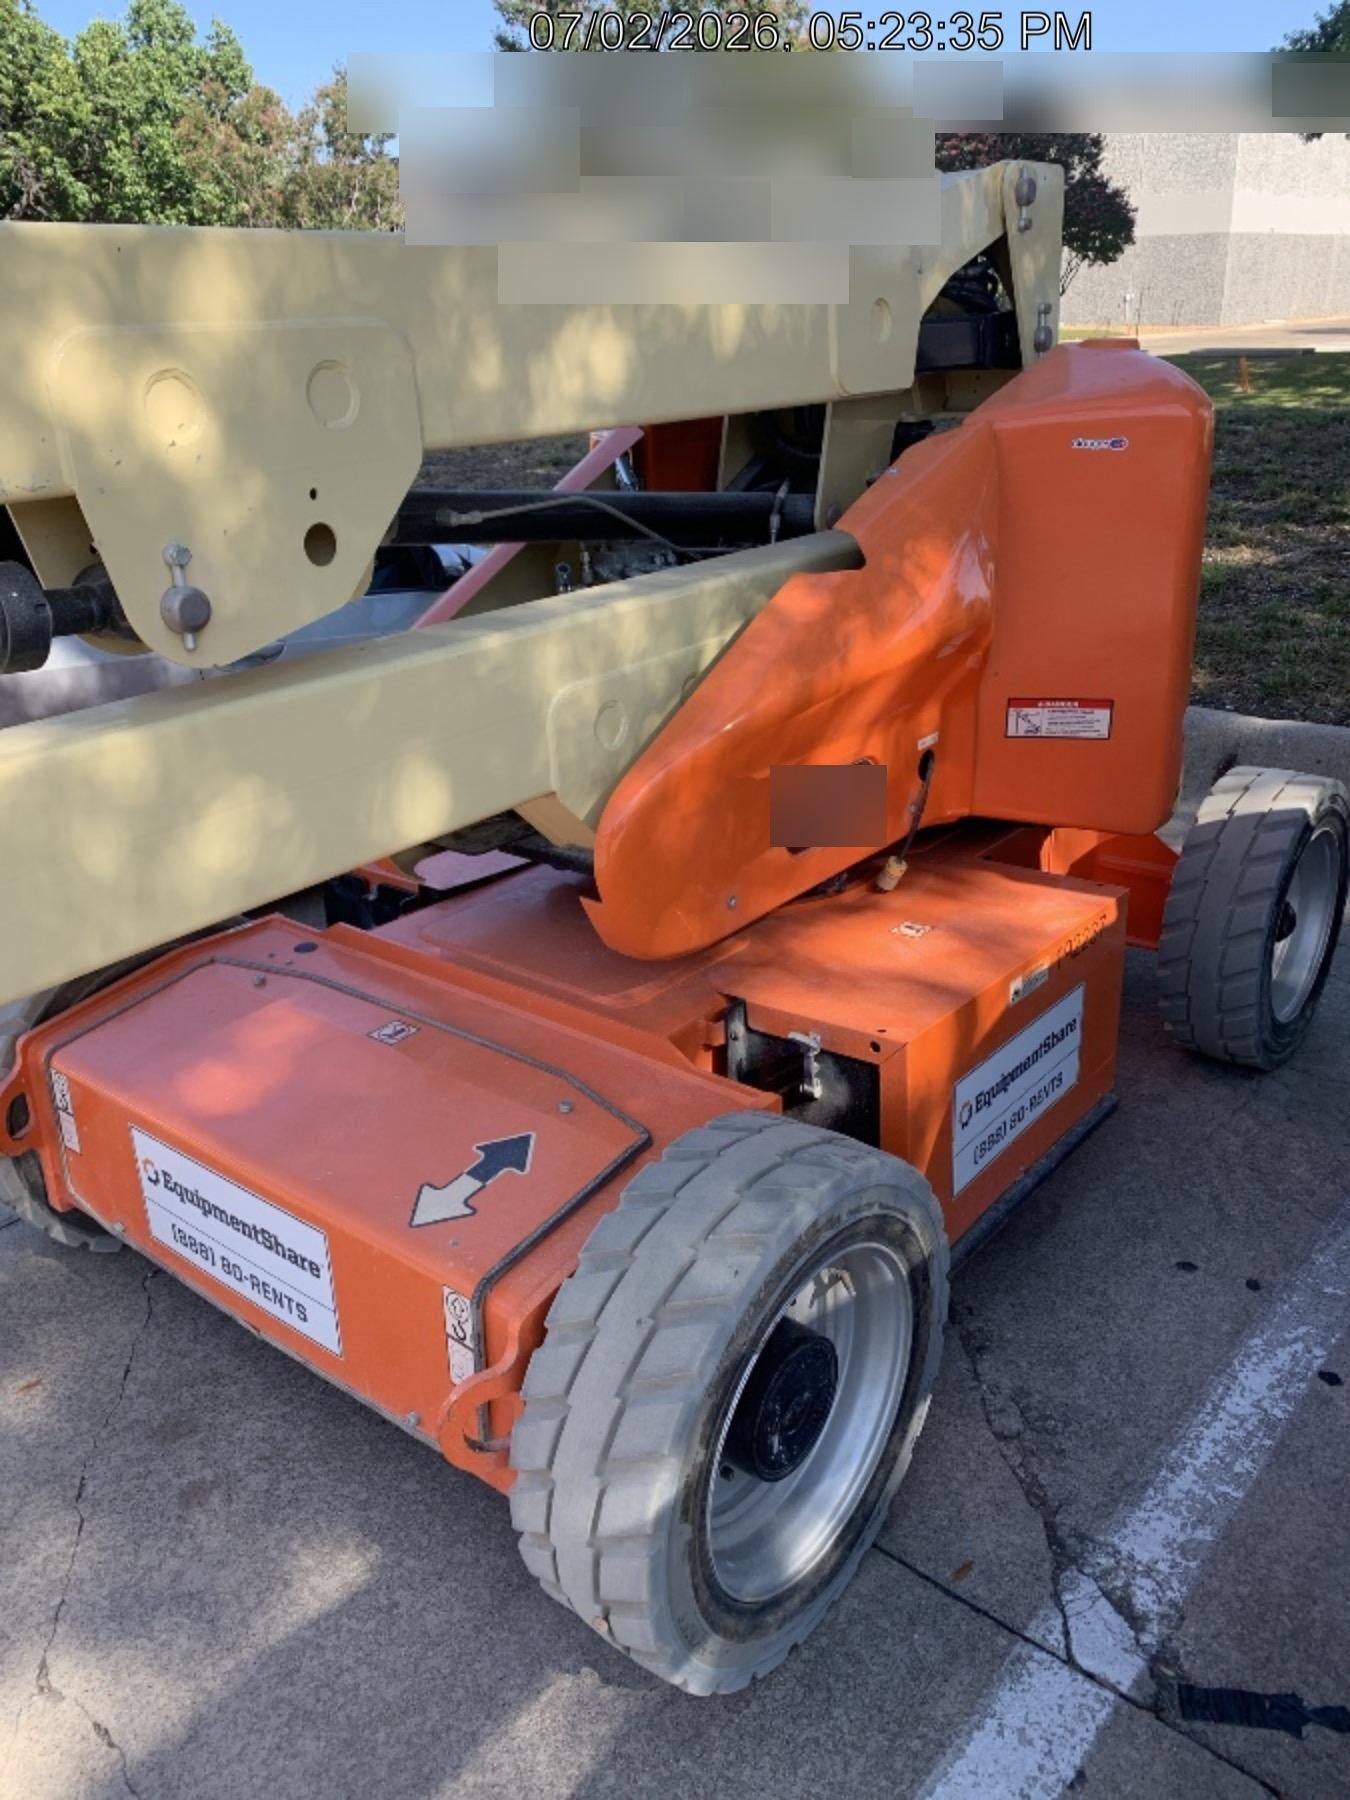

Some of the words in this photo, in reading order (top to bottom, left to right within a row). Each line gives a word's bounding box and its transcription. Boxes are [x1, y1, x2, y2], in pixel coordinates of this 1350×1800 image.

[975, 1017, 1078, 1113] EquipmentShare
[973, 1122, 1007, 1165] (888)
[1009, 1071, 1064, 1131] 80-RENTS
[161, 1170, 321, 1279] EquipmentShare
[171, 1223, 216, 1267] (888)
[220, 1254, 309, 1323] 80-RENTS
